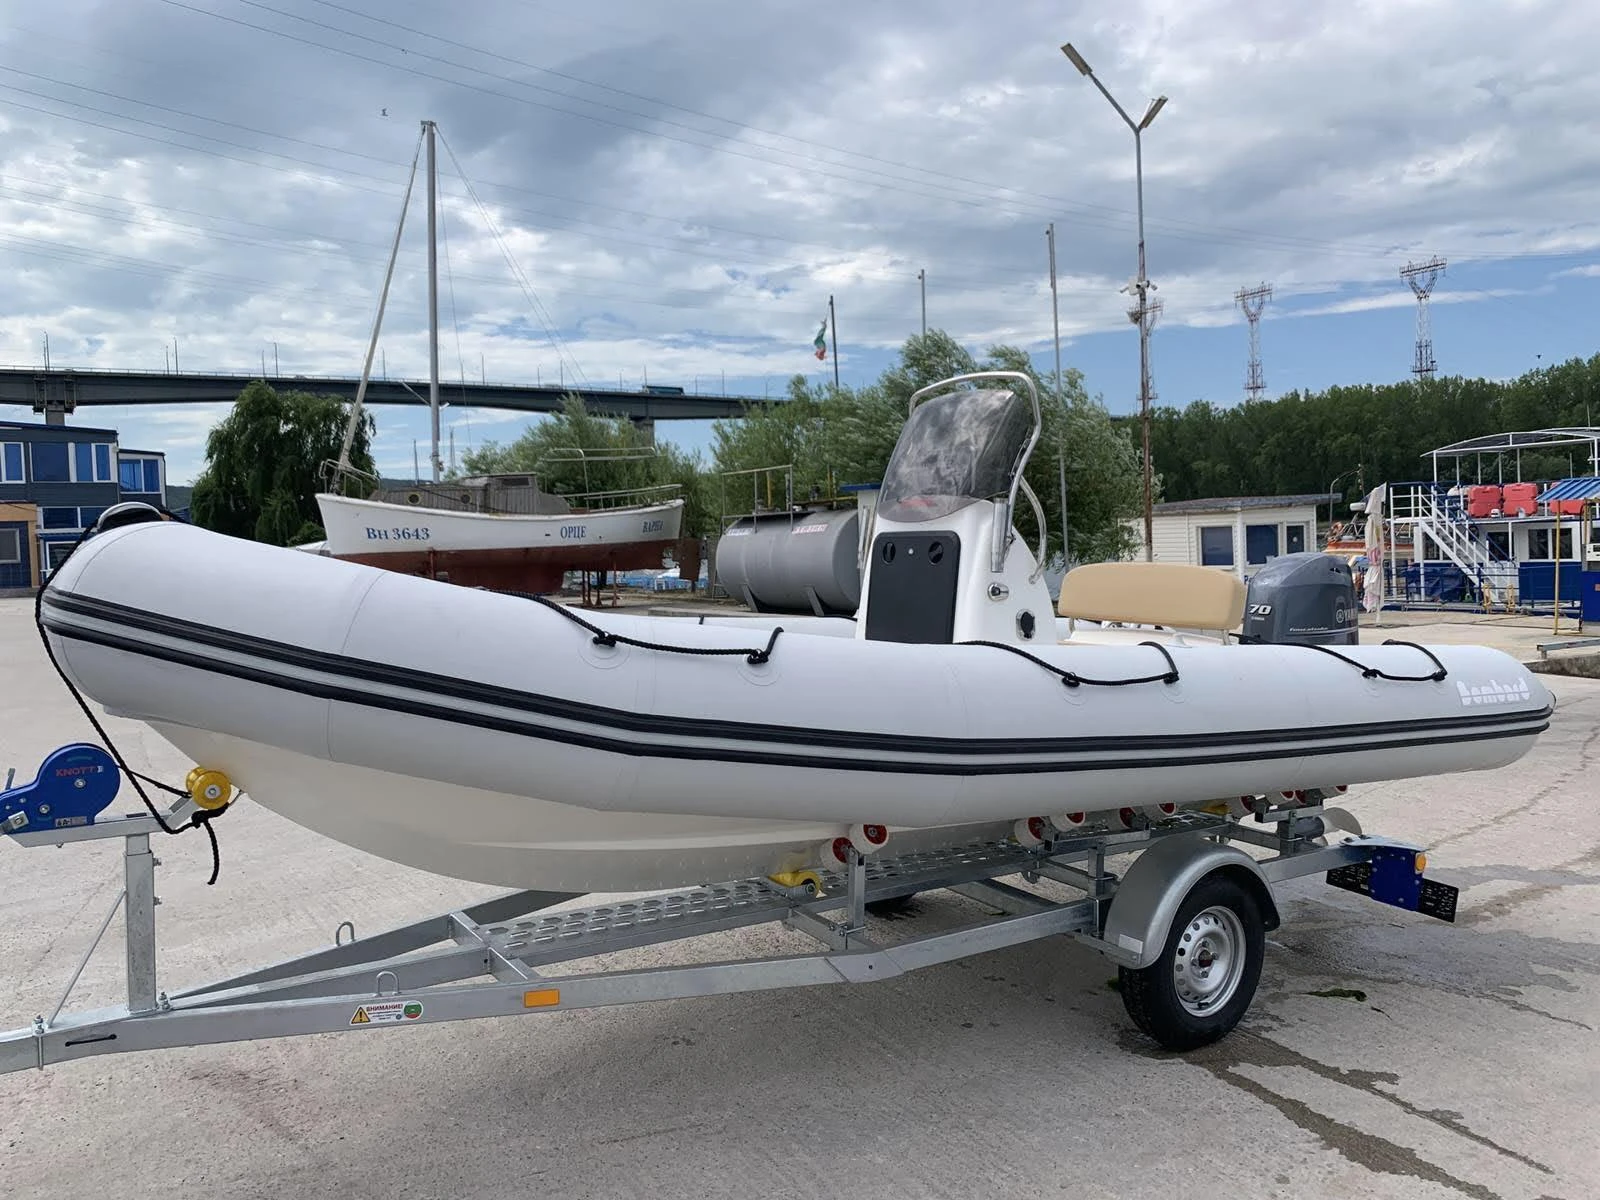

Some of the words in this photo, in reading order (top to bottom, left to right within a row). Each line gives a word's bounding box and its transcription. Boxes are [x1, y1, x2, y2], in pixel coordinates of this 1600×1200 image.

[392, 527, 430, 541] 3643
[1249, 604, 1272, 615] 70
[1456, 677, 1530, 706] Bombard
